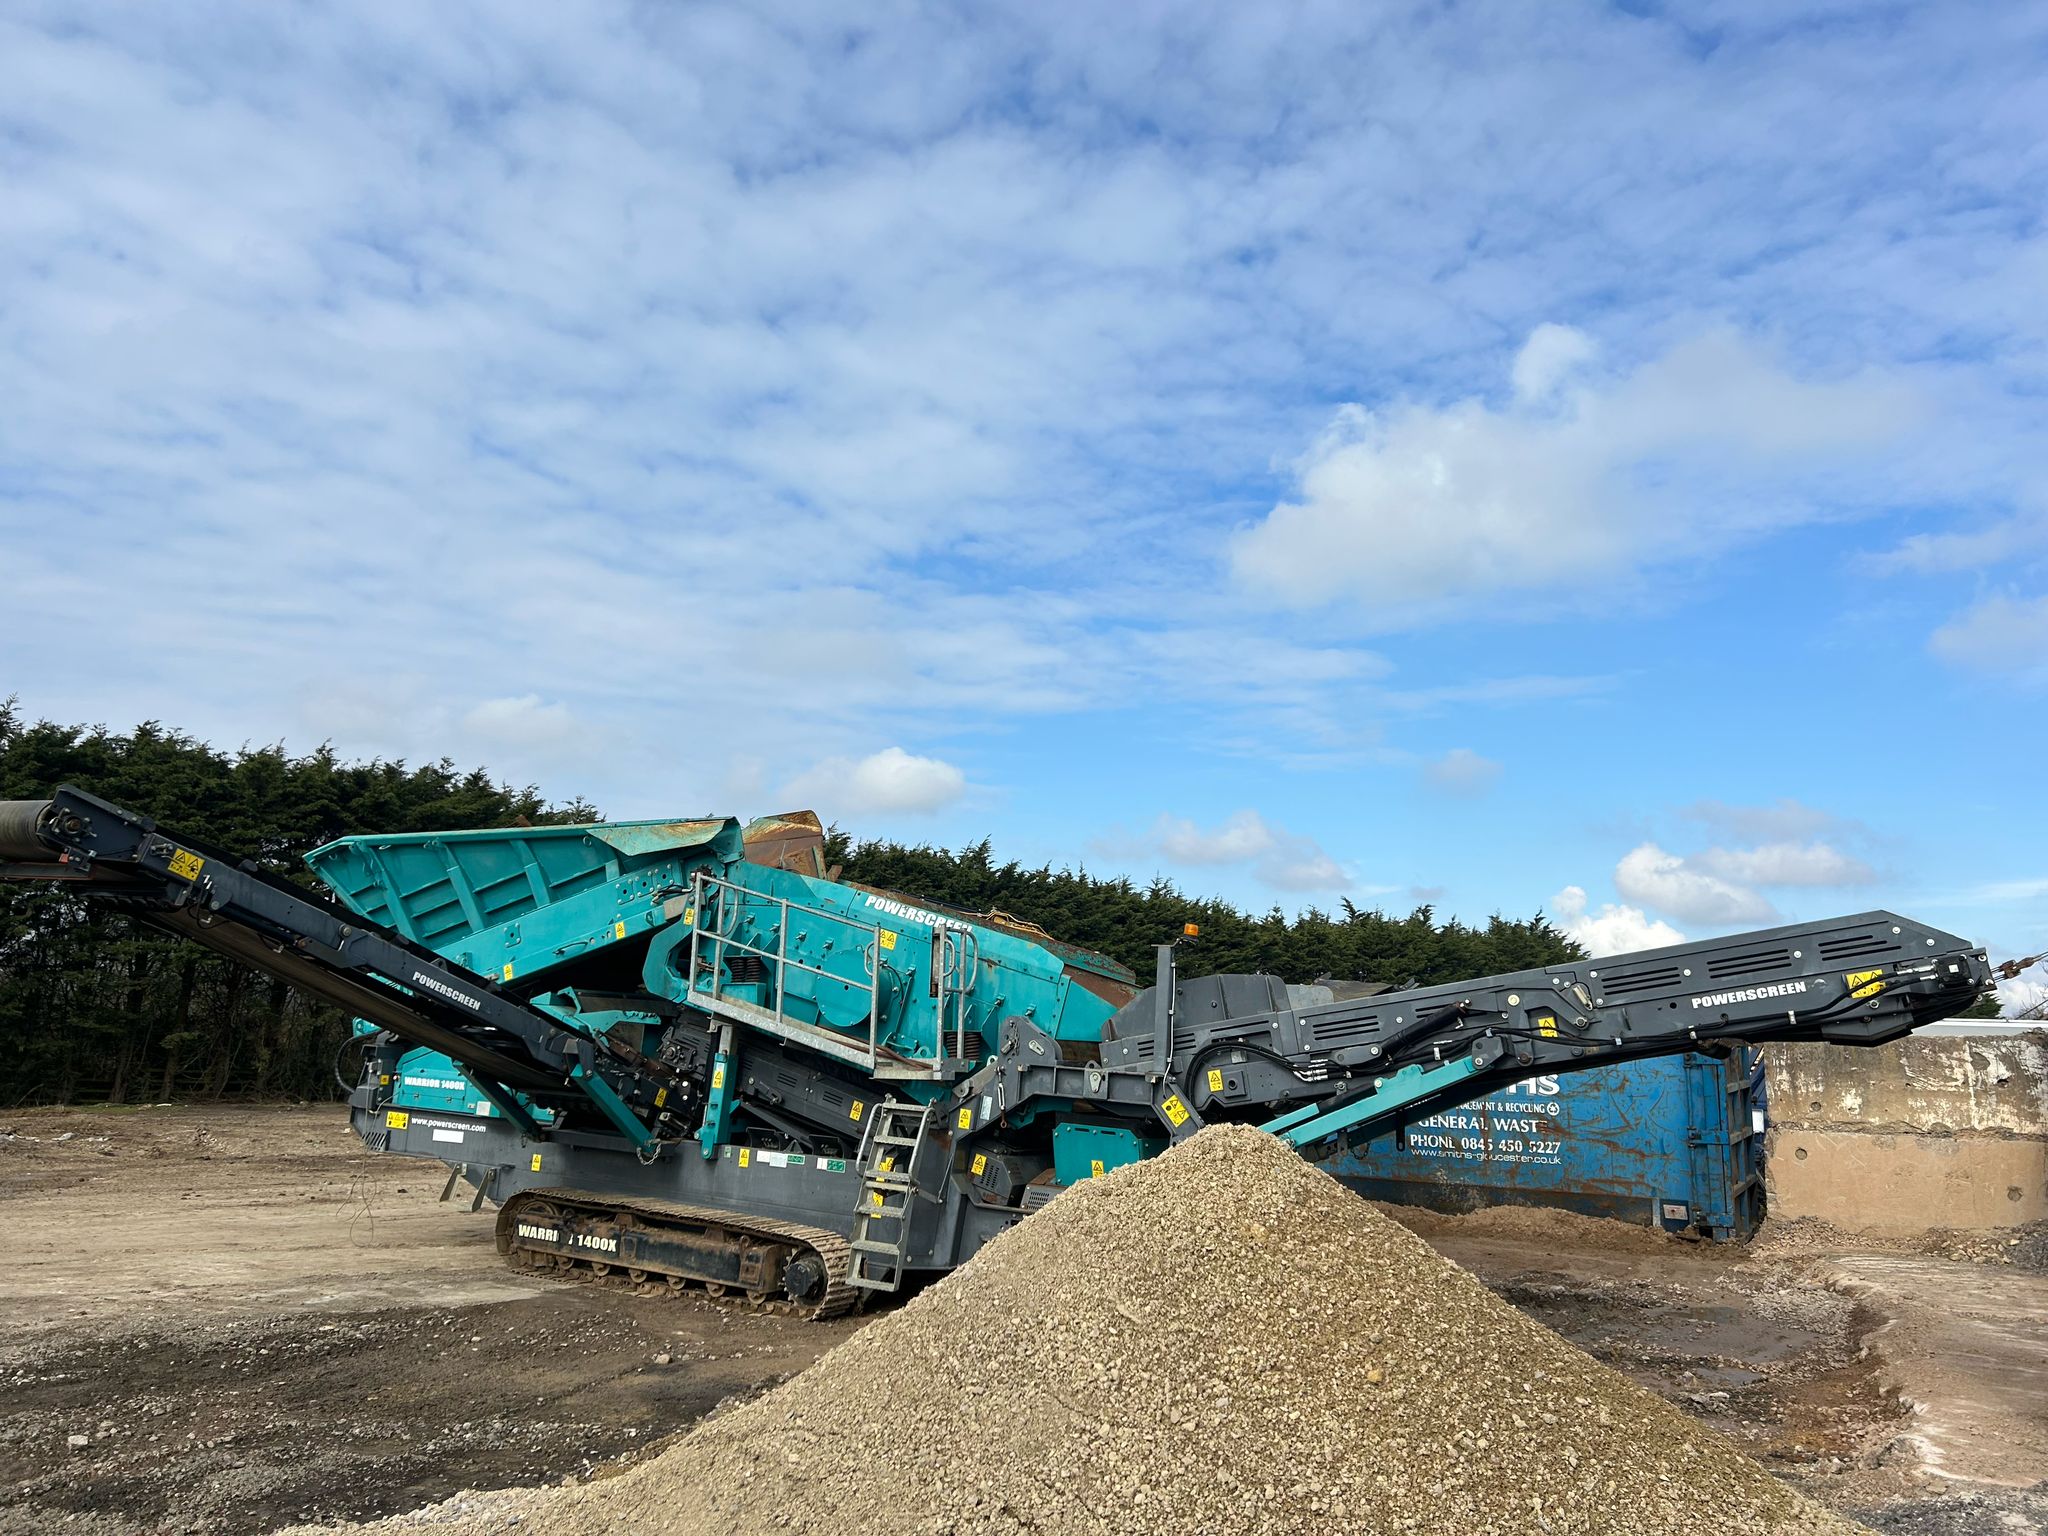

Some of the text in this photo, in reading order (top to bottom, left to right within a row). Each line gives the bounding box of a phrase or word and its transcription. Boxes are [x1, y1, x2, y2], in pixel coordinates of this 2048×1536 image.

[412, 971, 481, 1011] POWERSCREEN
[1691, 981, 1807, 1009] POWERSCREEN
[404, 1076, 465, 1091] WARRIOR 1400X
[1497, 1102, 1504, 1112] &
[411, 1117, 487, 1133] www.powerscreen.com
[1461, 1137, 1494, 1151] 0845
[1498, 1139, 1523, 1153] 450
[1528, 1141, 1561, 1154] 5227
[518, 1224, 617, 1253] WARRI 1400X
